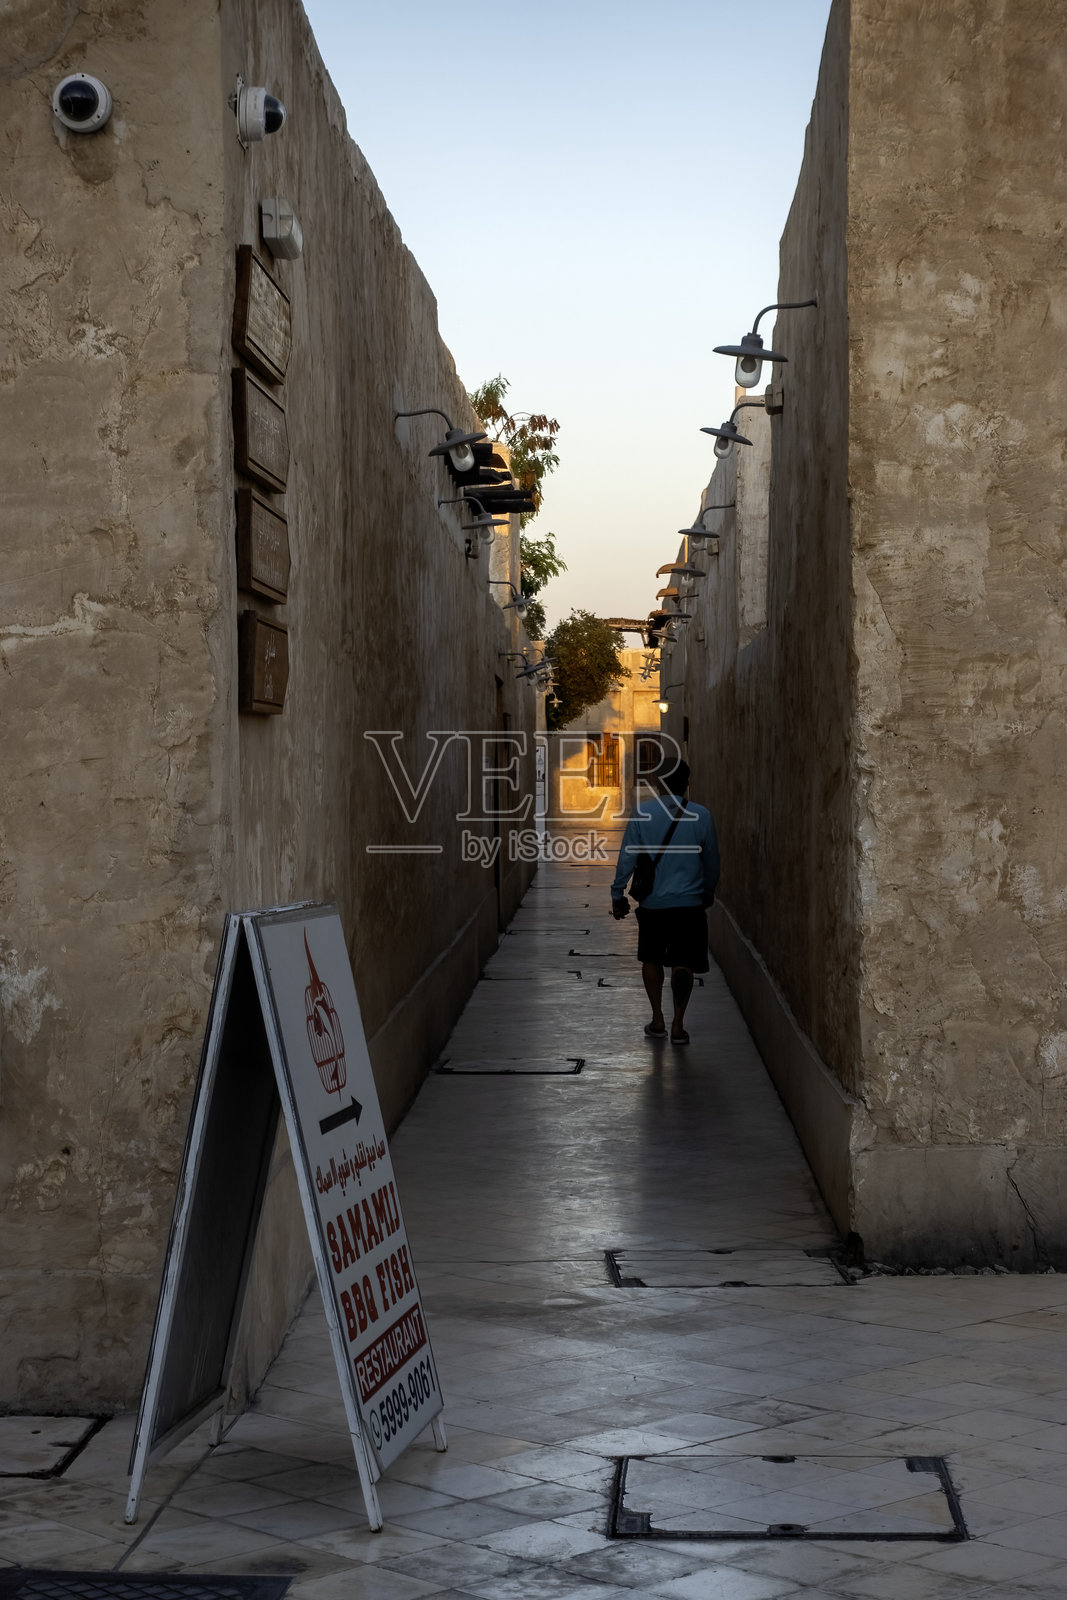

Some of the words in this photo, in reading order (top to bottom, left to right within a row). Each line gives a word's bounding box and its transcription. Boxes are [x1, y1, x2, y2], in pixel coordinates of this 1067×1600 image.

[326, 1181, 400, 1274] SAMAMIJ
[340, 1274, 379, 1343] BBQ
[375, 1244, 415, 1313] FISH
[356, 1308, 423, 1397] RESTAURANT
[379, 1354, 436, 1442] 5999-9061
